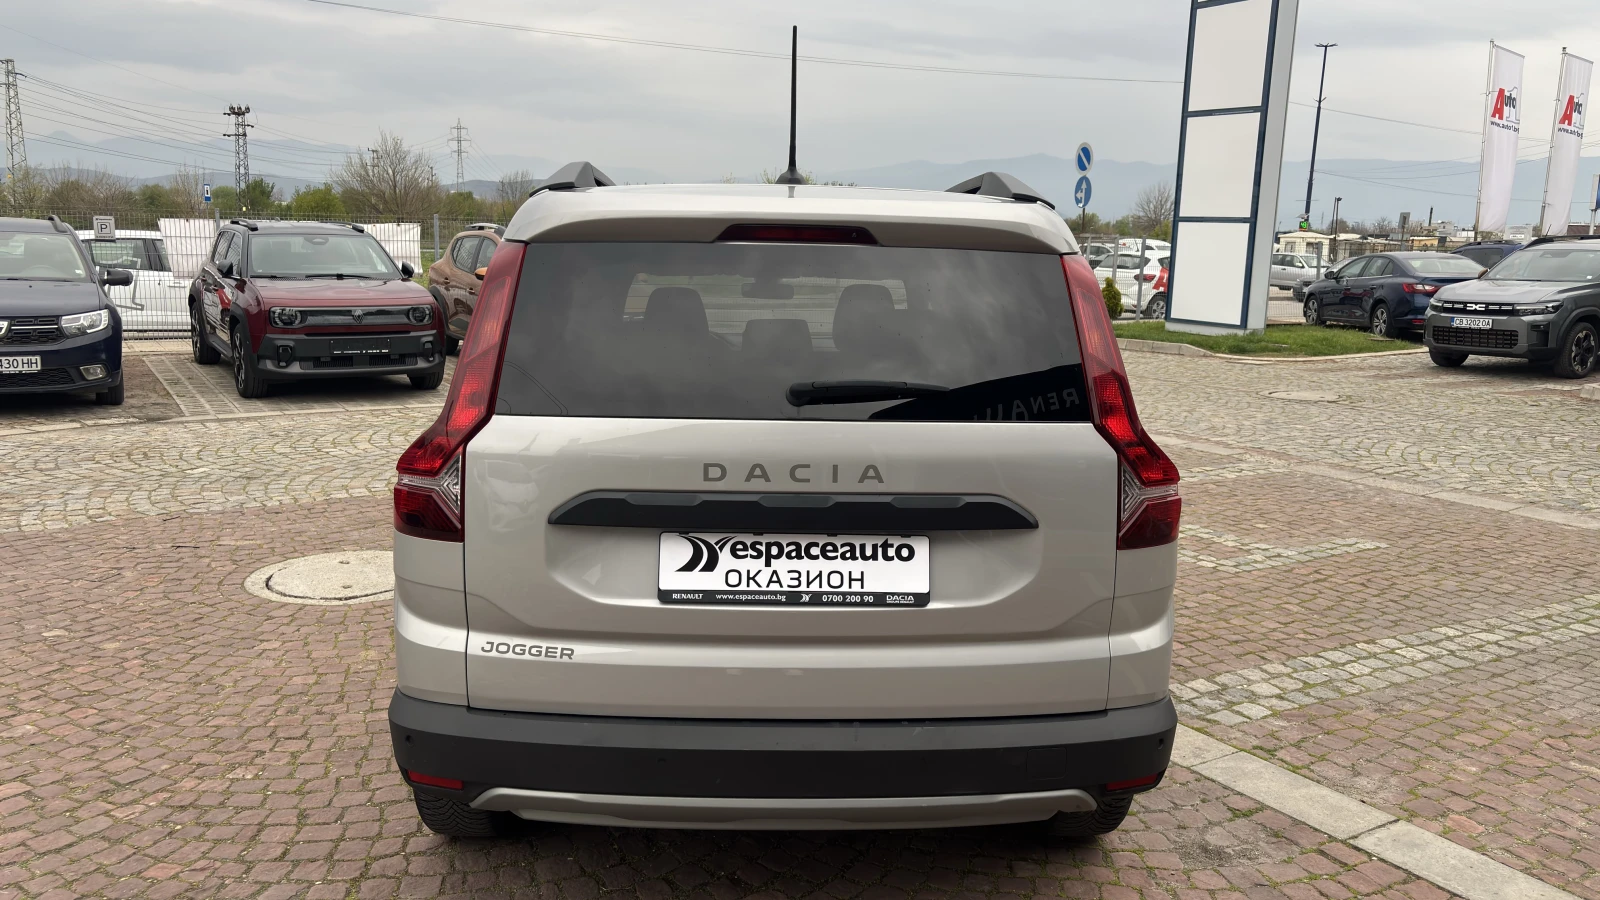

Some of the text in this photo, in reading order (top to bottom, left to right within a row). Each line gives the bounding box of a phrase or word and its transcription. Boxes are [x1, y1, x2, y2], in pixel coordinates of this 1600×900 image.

[100, 223, 108, 232] P
[21, 358, 38, 369] HH
[703, 462, 884, 484] DACIA
[729, 538, 916, 567] espaceauto
[724, 568, 865, 590] ОКАЗИОН
[715, 593, 787, 602] www.espaceauto.bg
[822, 594, 874, 603] 0700 200 90
[481, 641, 575, 660] JOGGER
